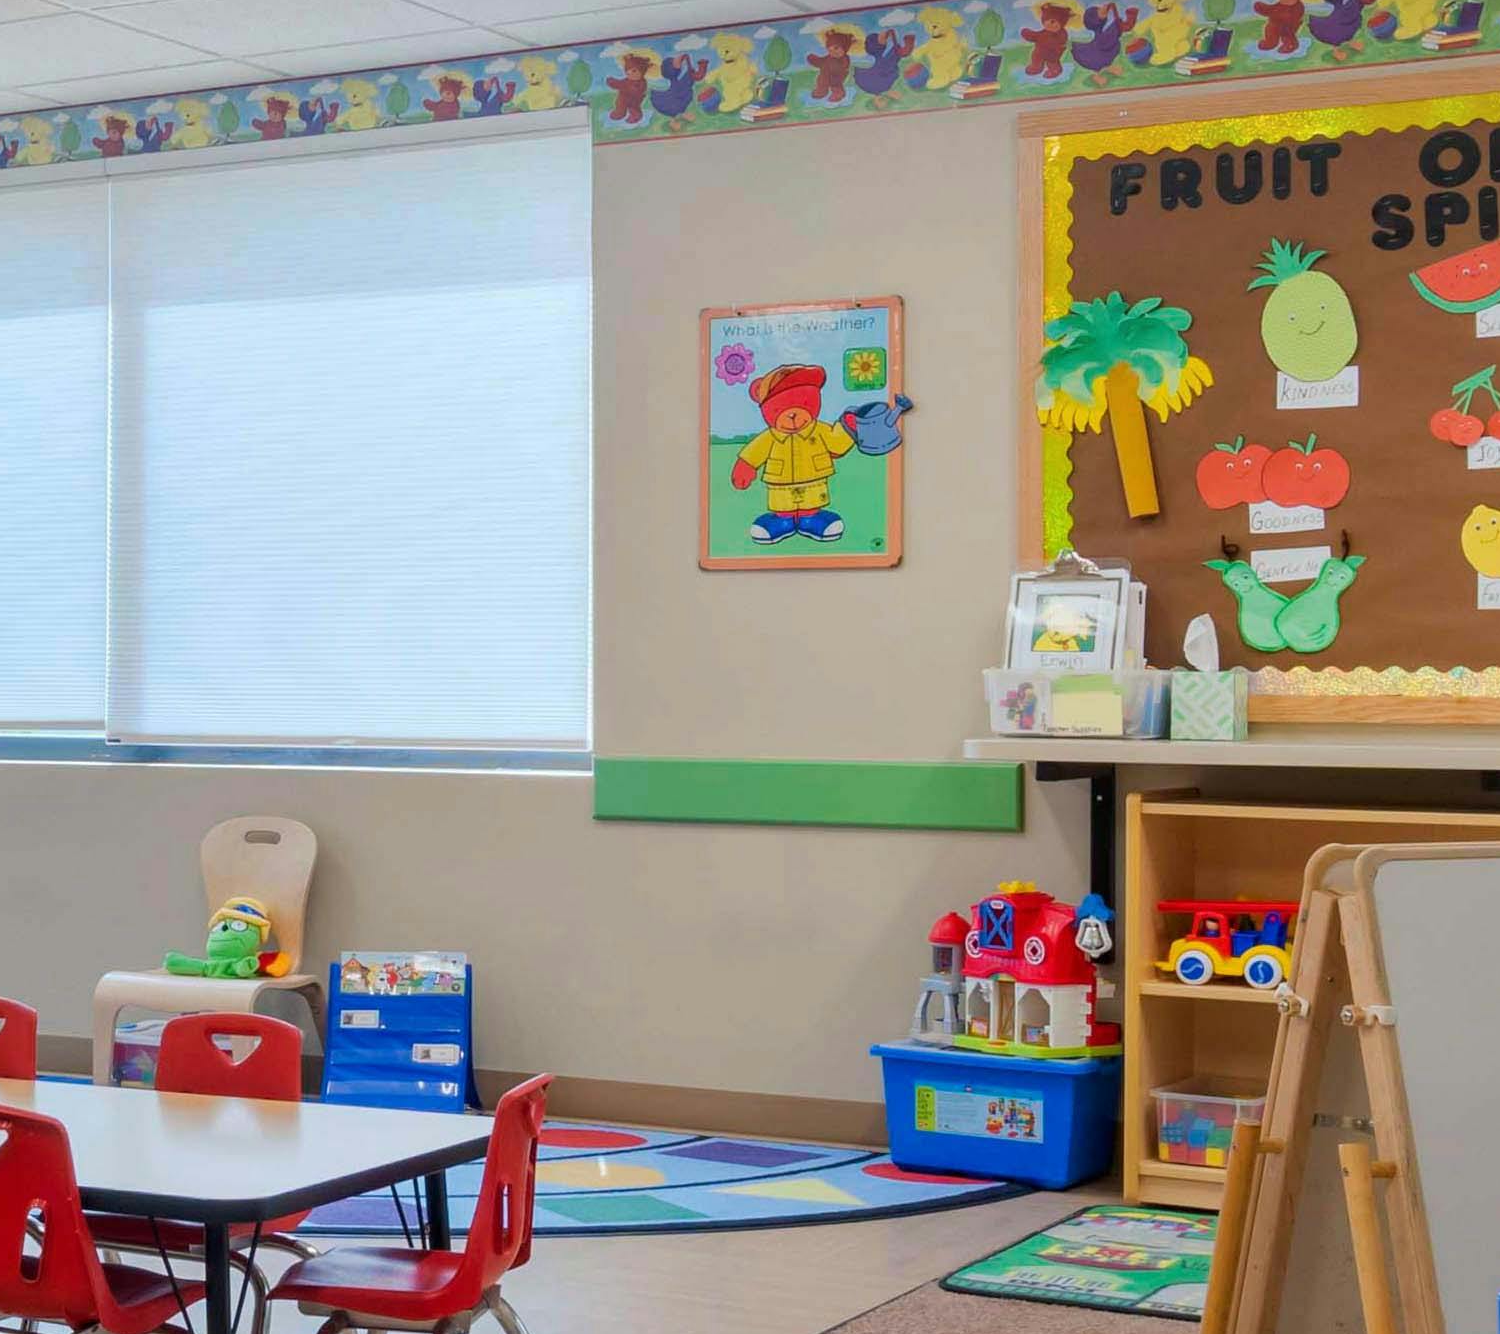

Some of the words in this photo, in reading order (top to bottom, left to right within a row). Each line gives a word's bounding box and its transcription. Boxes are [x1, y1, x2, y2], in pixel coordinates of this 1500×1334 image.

[1110, 142, 1342, 216] FRUIT
[723, 323, 760, 338] What
[777, 321, 801, 335] the
[805, 316, 876, 332] Weather?
